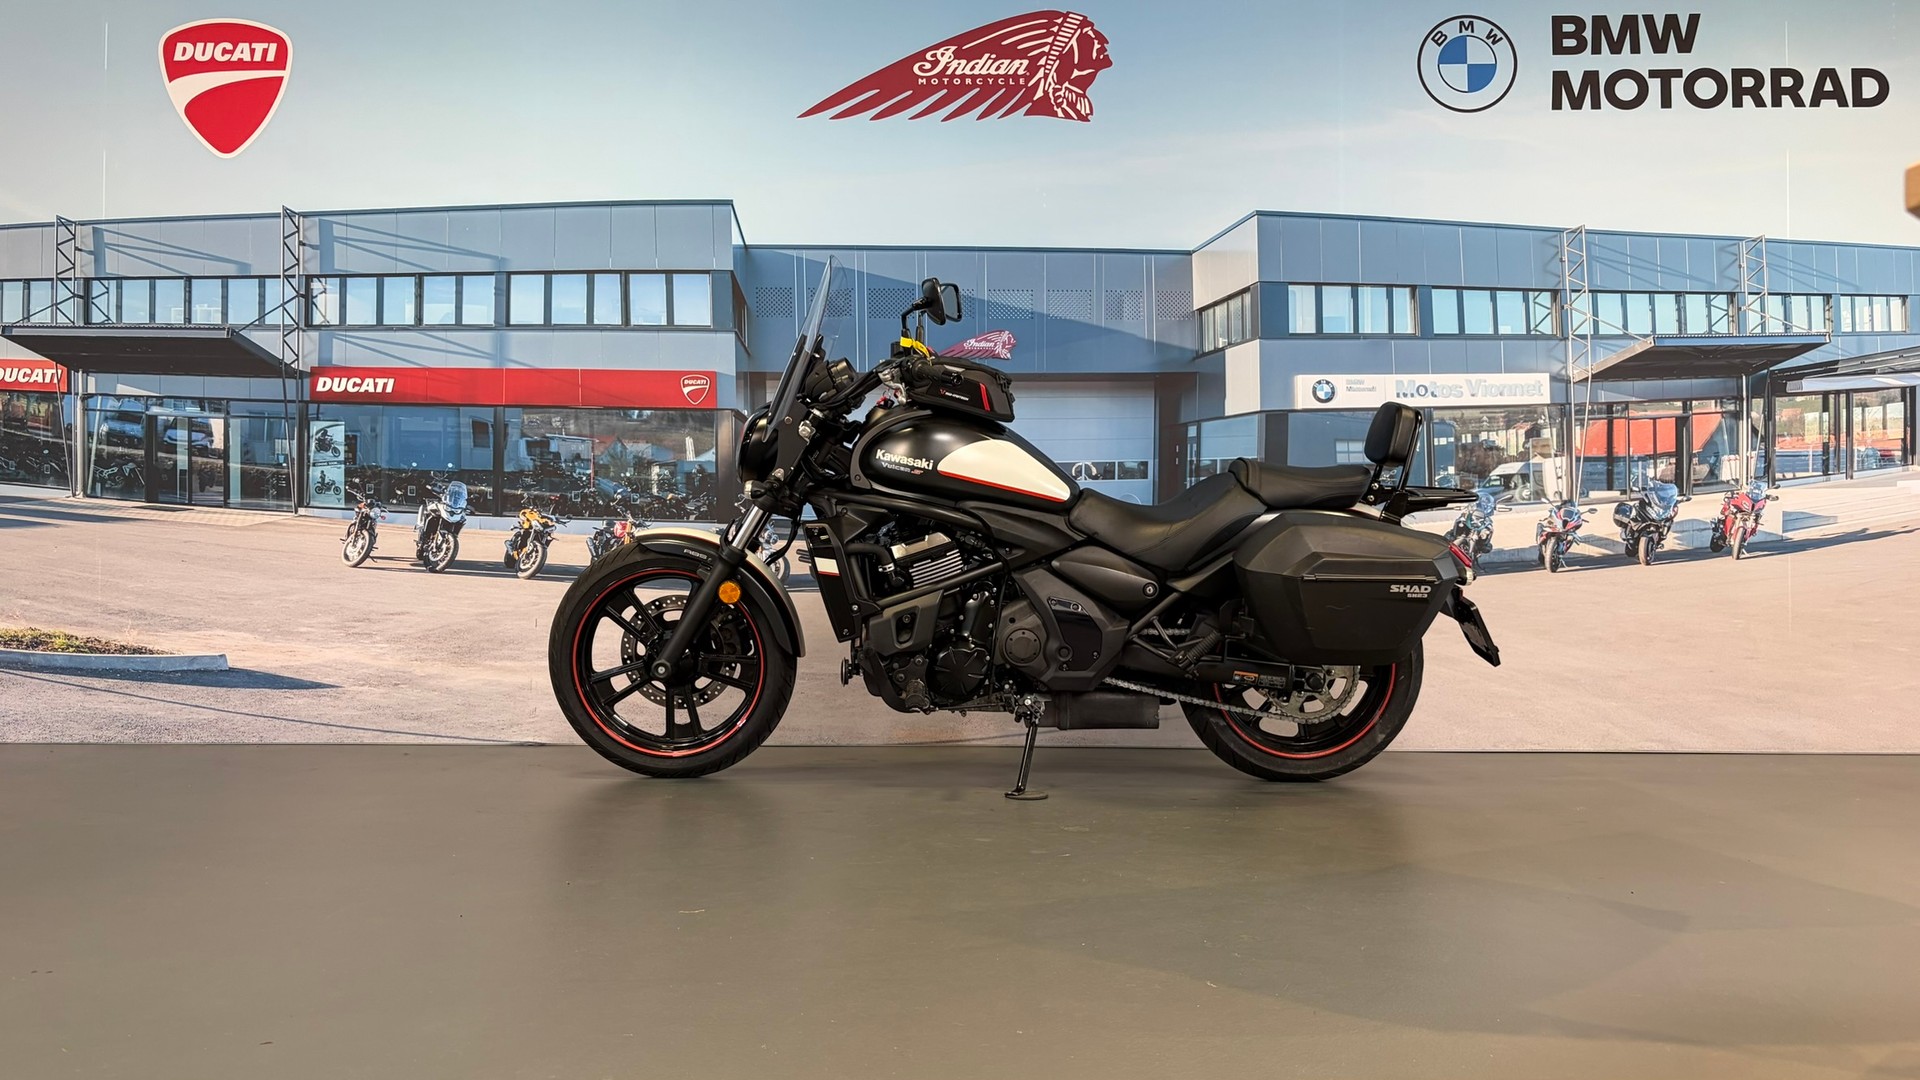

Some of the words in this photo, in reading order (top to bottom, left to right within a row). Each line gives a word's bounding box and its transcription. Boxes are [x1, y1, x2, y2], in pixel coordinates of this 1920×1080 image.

[1430, 20, 1504, 47] BMW
[1551, 13, 1701, 55] BMW
[173, 41, 278, 62] DUCATI
[913, 46, 1030, 76] Indian
[1551, 67, 1890, 110] MOTORRAD
[963, 338, 995, 347] Indian
[316, 376, 395, 393] DUCATI
[1395, 379, 1463, 399] Motos
[1465, 378, 1544, 398] Vionnet
[875, 448, 934, 470] Kawasaki
[881, 461, 911, 473] Vulcan
[1390, 584, 1431, 593] SHAD
